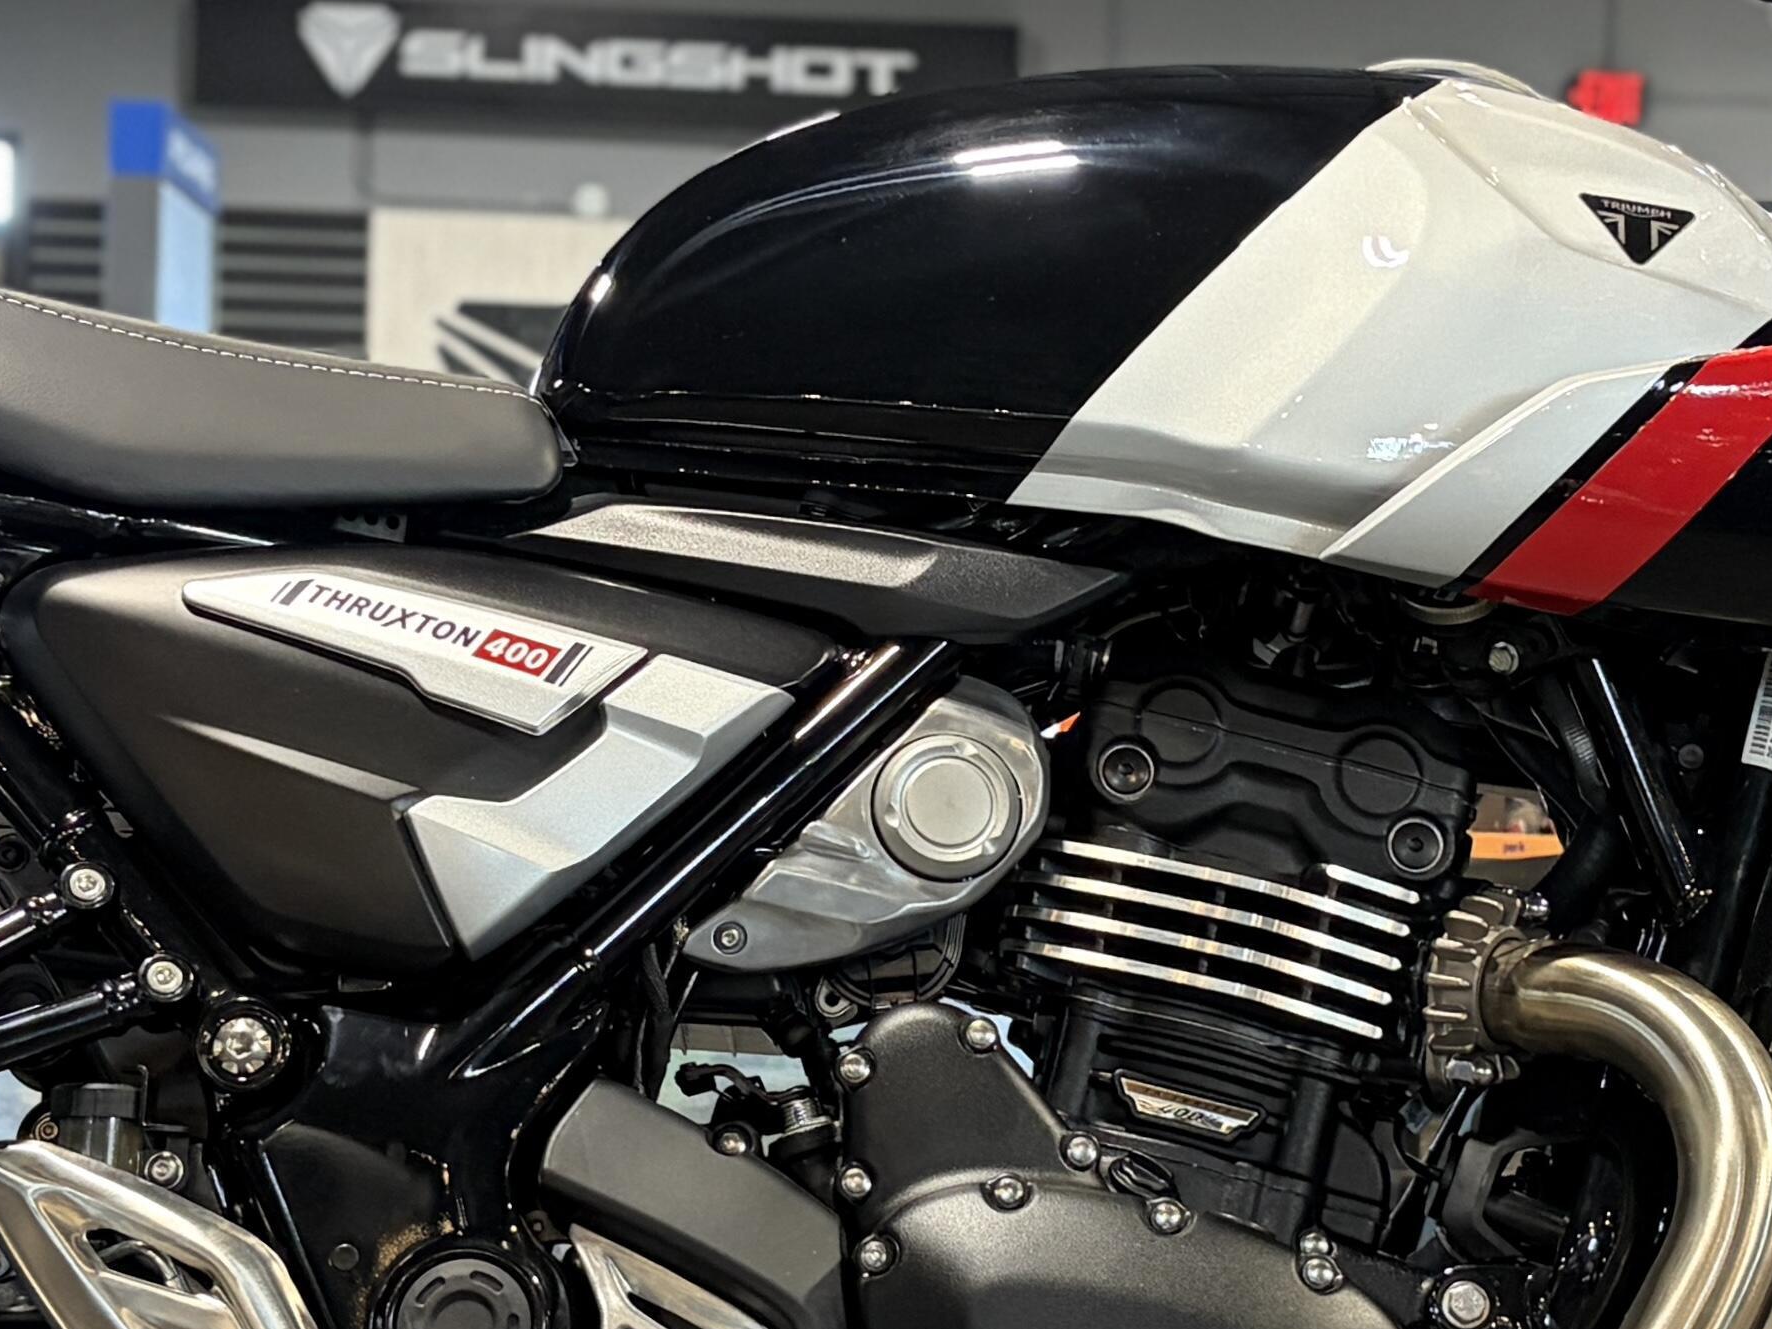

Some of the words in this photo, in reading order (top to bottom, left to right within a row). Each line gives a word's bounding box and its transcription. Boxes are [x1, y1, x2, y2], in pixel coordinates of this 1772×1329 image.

[399, 28, 918, 97] SLINGSHOT
[1601, 199, 1672, 219] TRIUMPH
[307, 584, 481, 647] THRUXTON
[483, 637, 549, 671] 400
